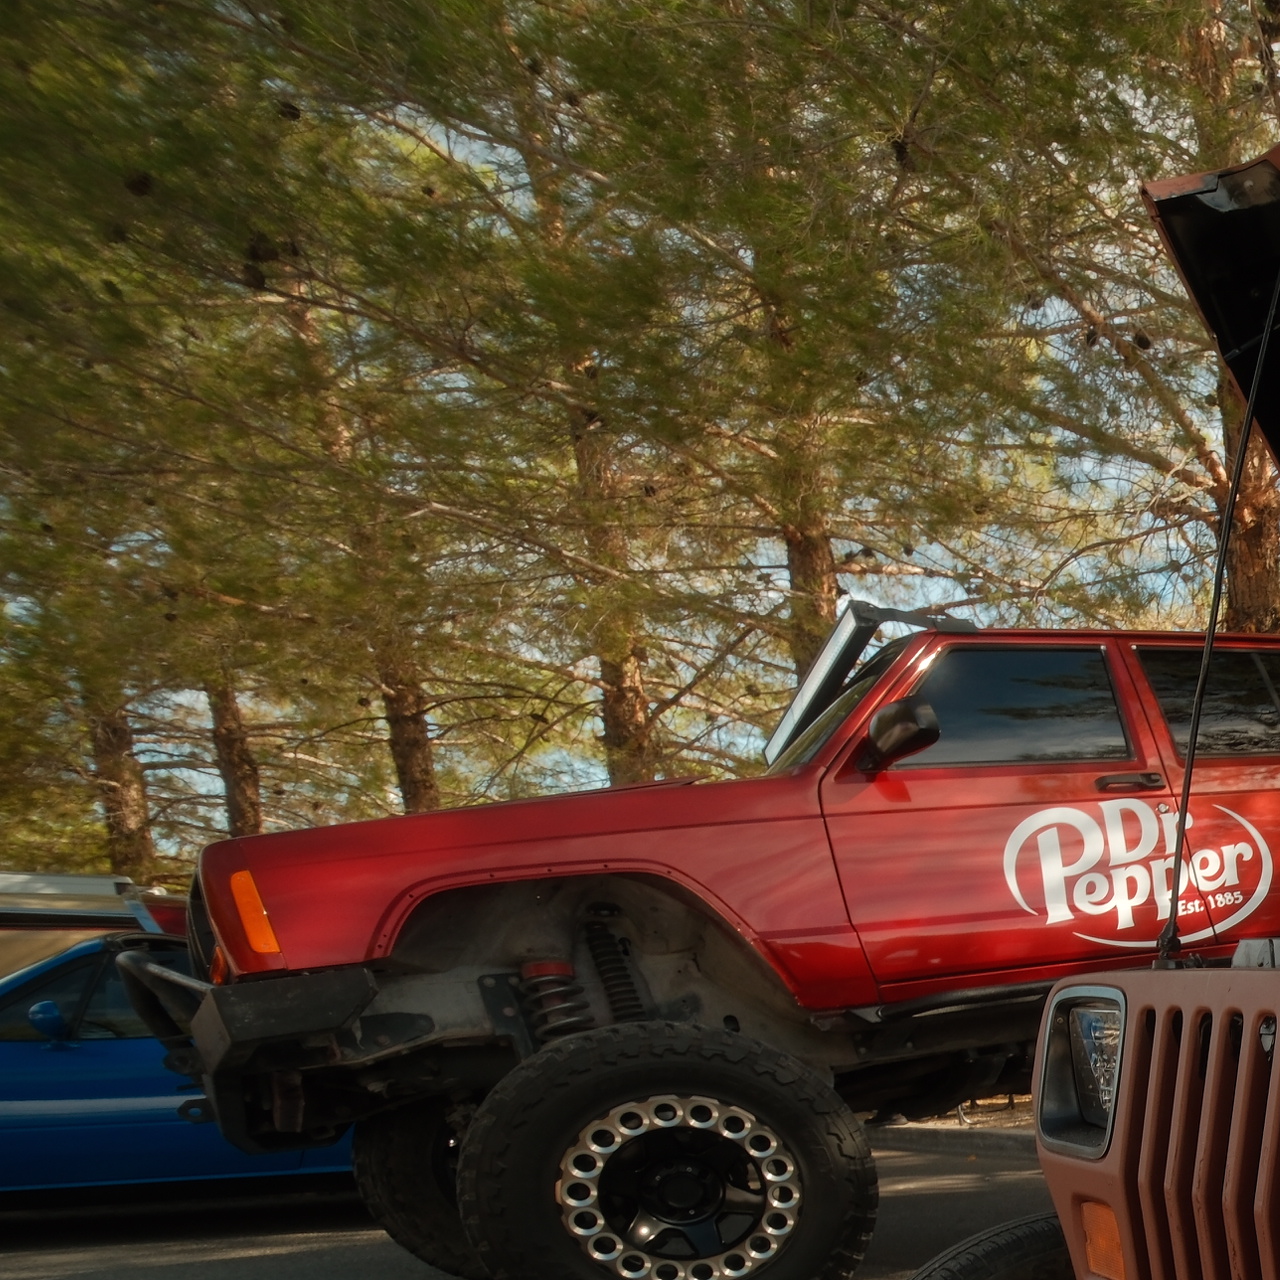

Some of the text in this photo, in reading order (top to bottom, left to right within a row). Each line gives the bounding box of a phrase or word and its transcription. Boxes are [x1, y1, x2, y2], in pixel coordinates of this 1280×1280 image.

[1098, 797, 1193, 867] Dr
[1003, 806, 1253, 930] Pepper
[1178, 891, 1244, 917] Est. 1885
